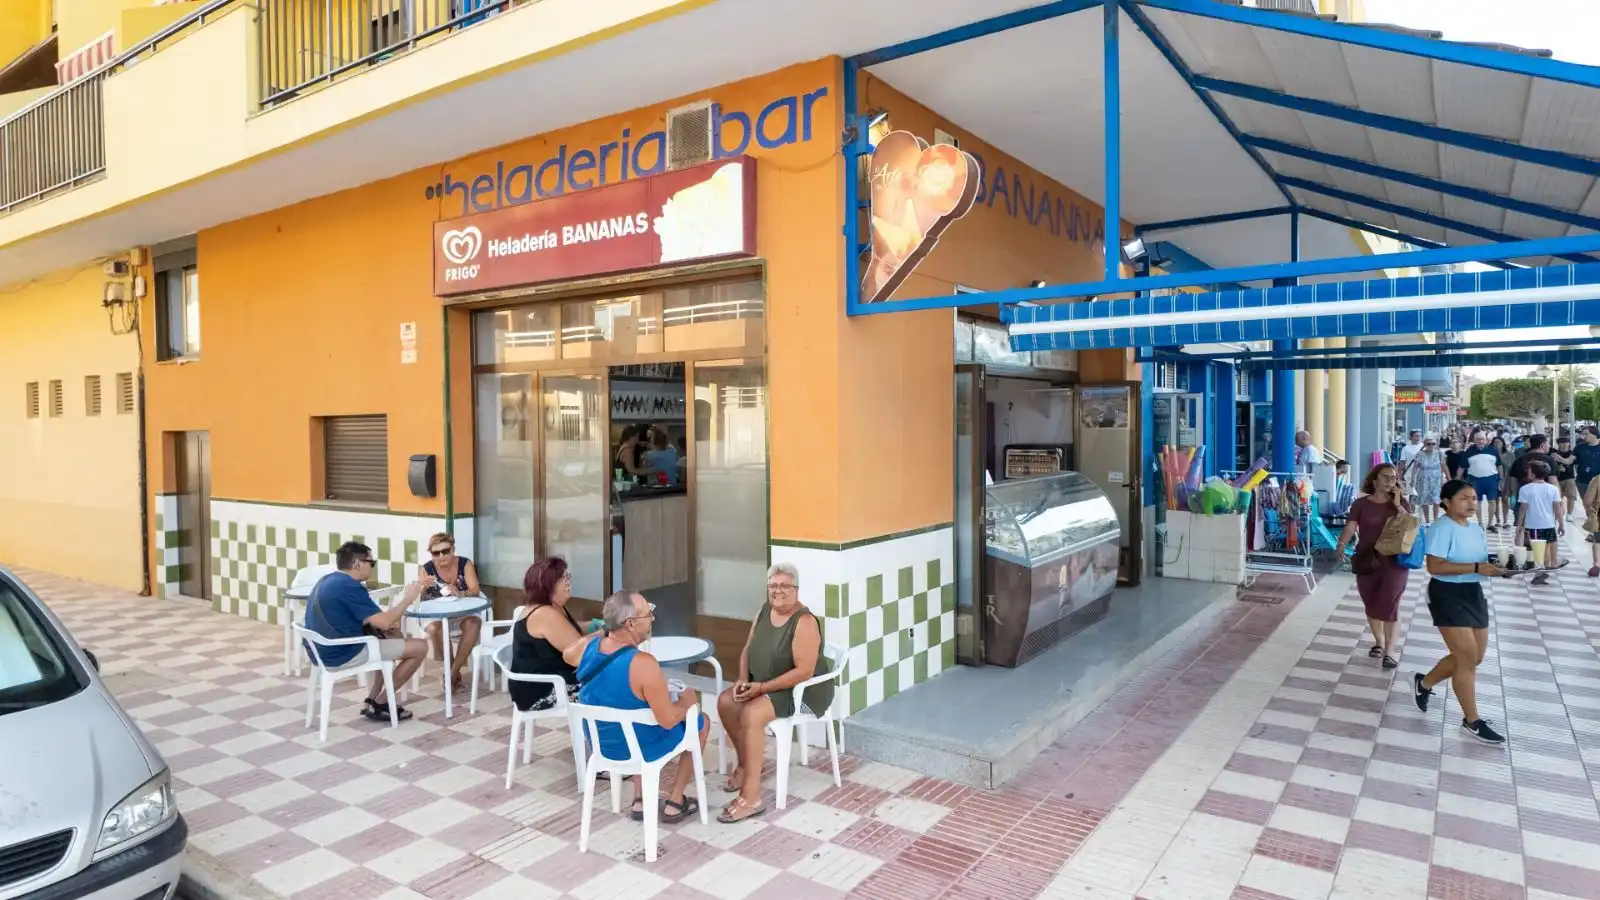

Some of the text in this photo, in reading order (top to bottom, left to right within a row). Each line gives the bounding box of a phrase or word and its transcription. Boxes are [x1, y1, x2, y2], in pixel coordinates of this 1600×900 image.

[712, 86, 828, 160] bar
[488, 212, 649, 258] Heladería BANANAS
[445, 265, 479, 282] FRIGO
